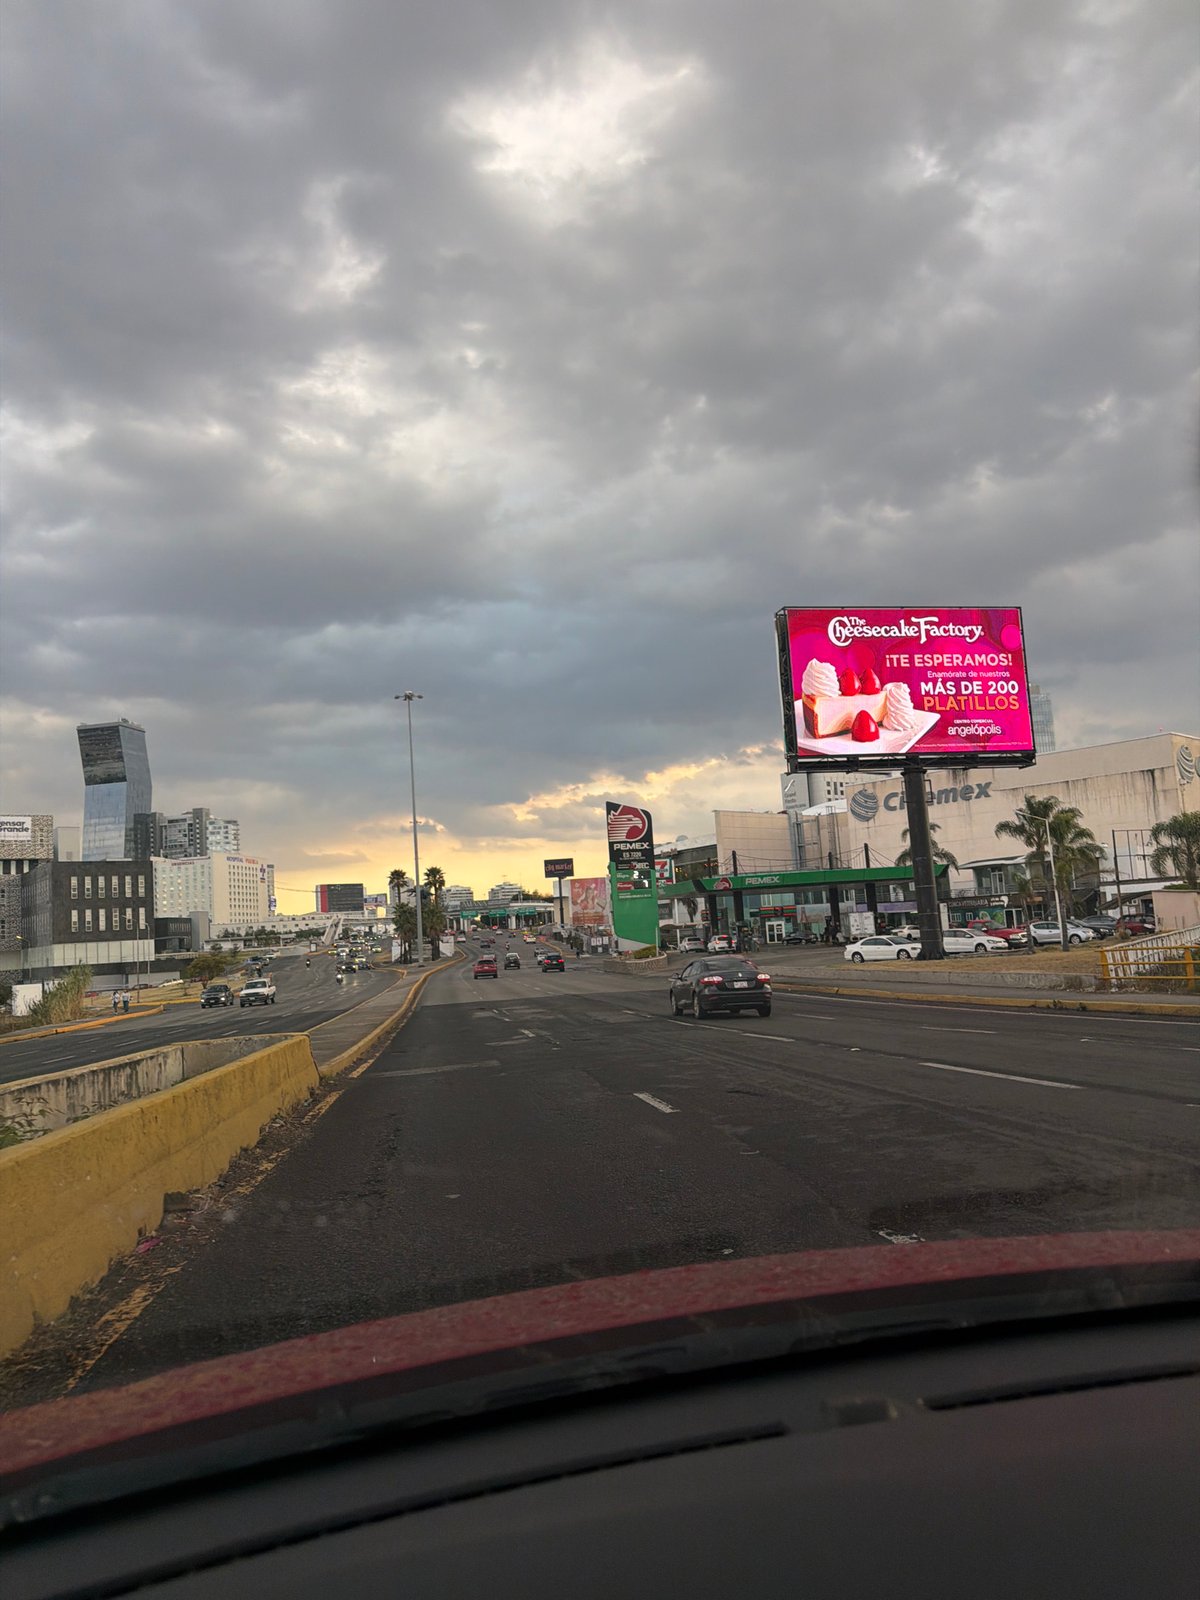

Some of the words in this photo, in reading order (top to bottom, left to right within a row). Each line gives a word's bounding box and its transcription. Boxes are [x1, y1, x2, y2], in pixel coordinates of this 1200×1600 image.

[849, 617, 867, 626] The
[828, 616, 918, 647] Cheesecake
[911, 616, 982, 644] Factory
[885, 655, 910, 668] ¡TE
[914, 653, 1013, 667] ESPERAMOS!
[927, 670, 967, 678] Enamórate
[968, 670, 978, 678] de
[920, 678, 957, 695] MÁS
[960, 681, 985, 695] DE
[987, 680, 1019, 695] 200
[923, 695, 1020, 711] PLATILLOS
[947, 723, 1002, 737] angelópolis
[882, 781, 993, 811] Ciemex
[0, 820, 26, 828] ensar
[613, 841, 650, 851] PEMEX
[745, 875, 780, 885] PEMEX
